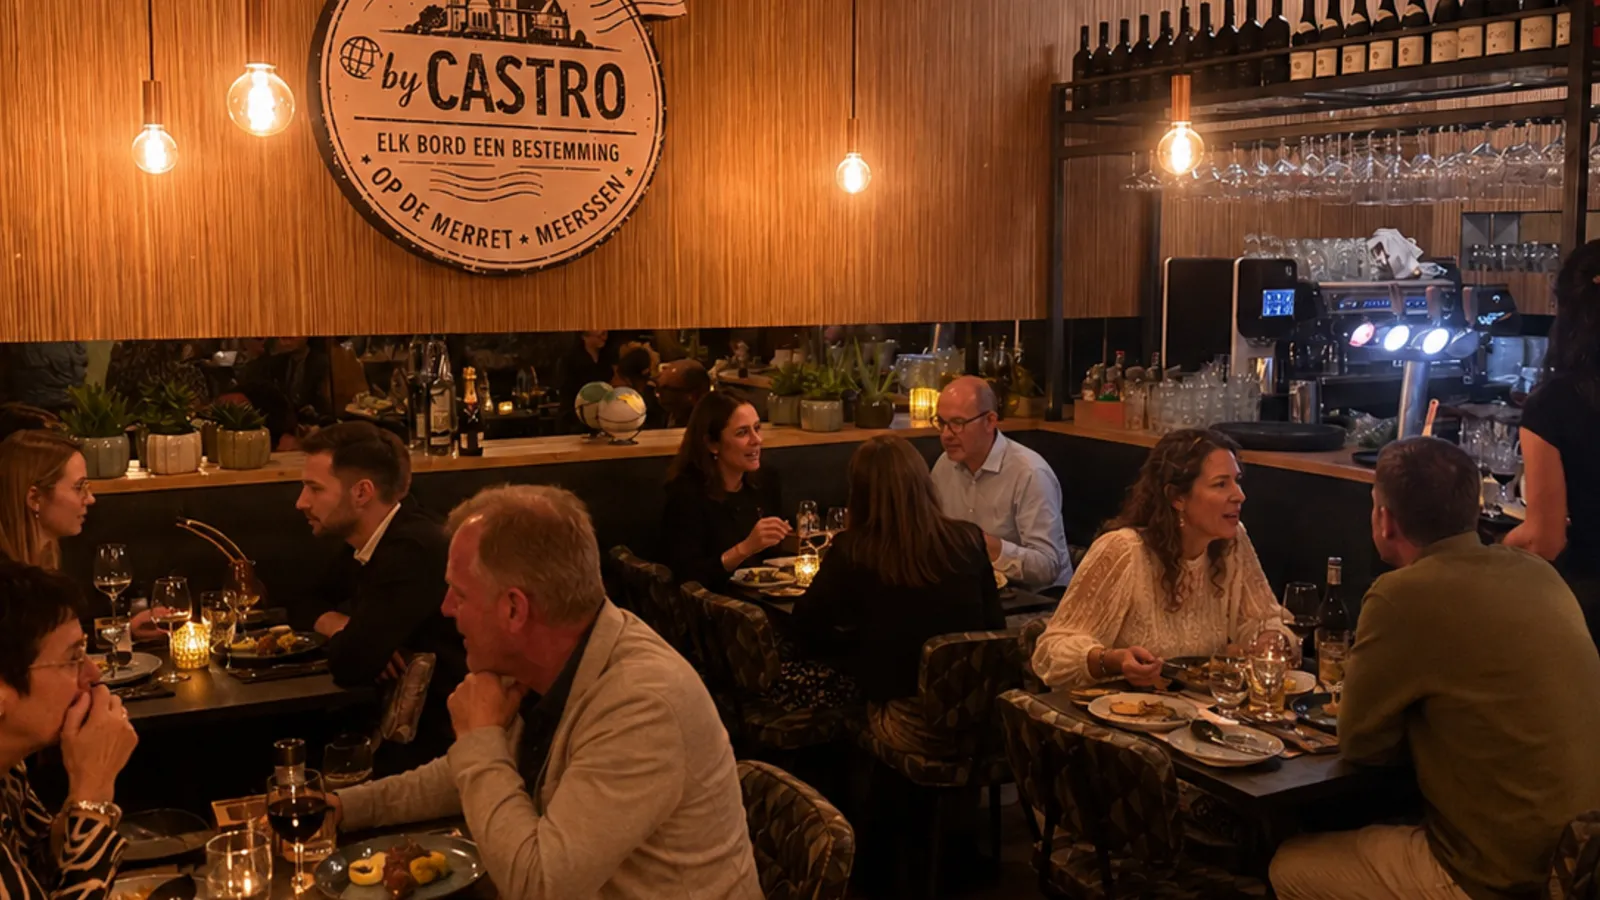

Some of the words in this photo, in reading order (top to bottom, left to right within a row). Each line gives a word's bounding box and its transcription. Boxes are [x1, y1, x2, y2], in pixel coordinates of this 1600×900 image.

[381, 52, 422, 107] by
[427, 50, 626, 120] CASTRO
[377, 132, 410, 153] ELK
[418, 134, 467, 155] BORD
[473, 137, 505, 157] EEN
[512, 140, 620, 163] BESTEMMING
[371, 166, 402, 194] OP
[398, 193, 430, 223] DE
[430, 212, 513, 250] MERRET
[534, 174, 625, 246] MEERSSEN
